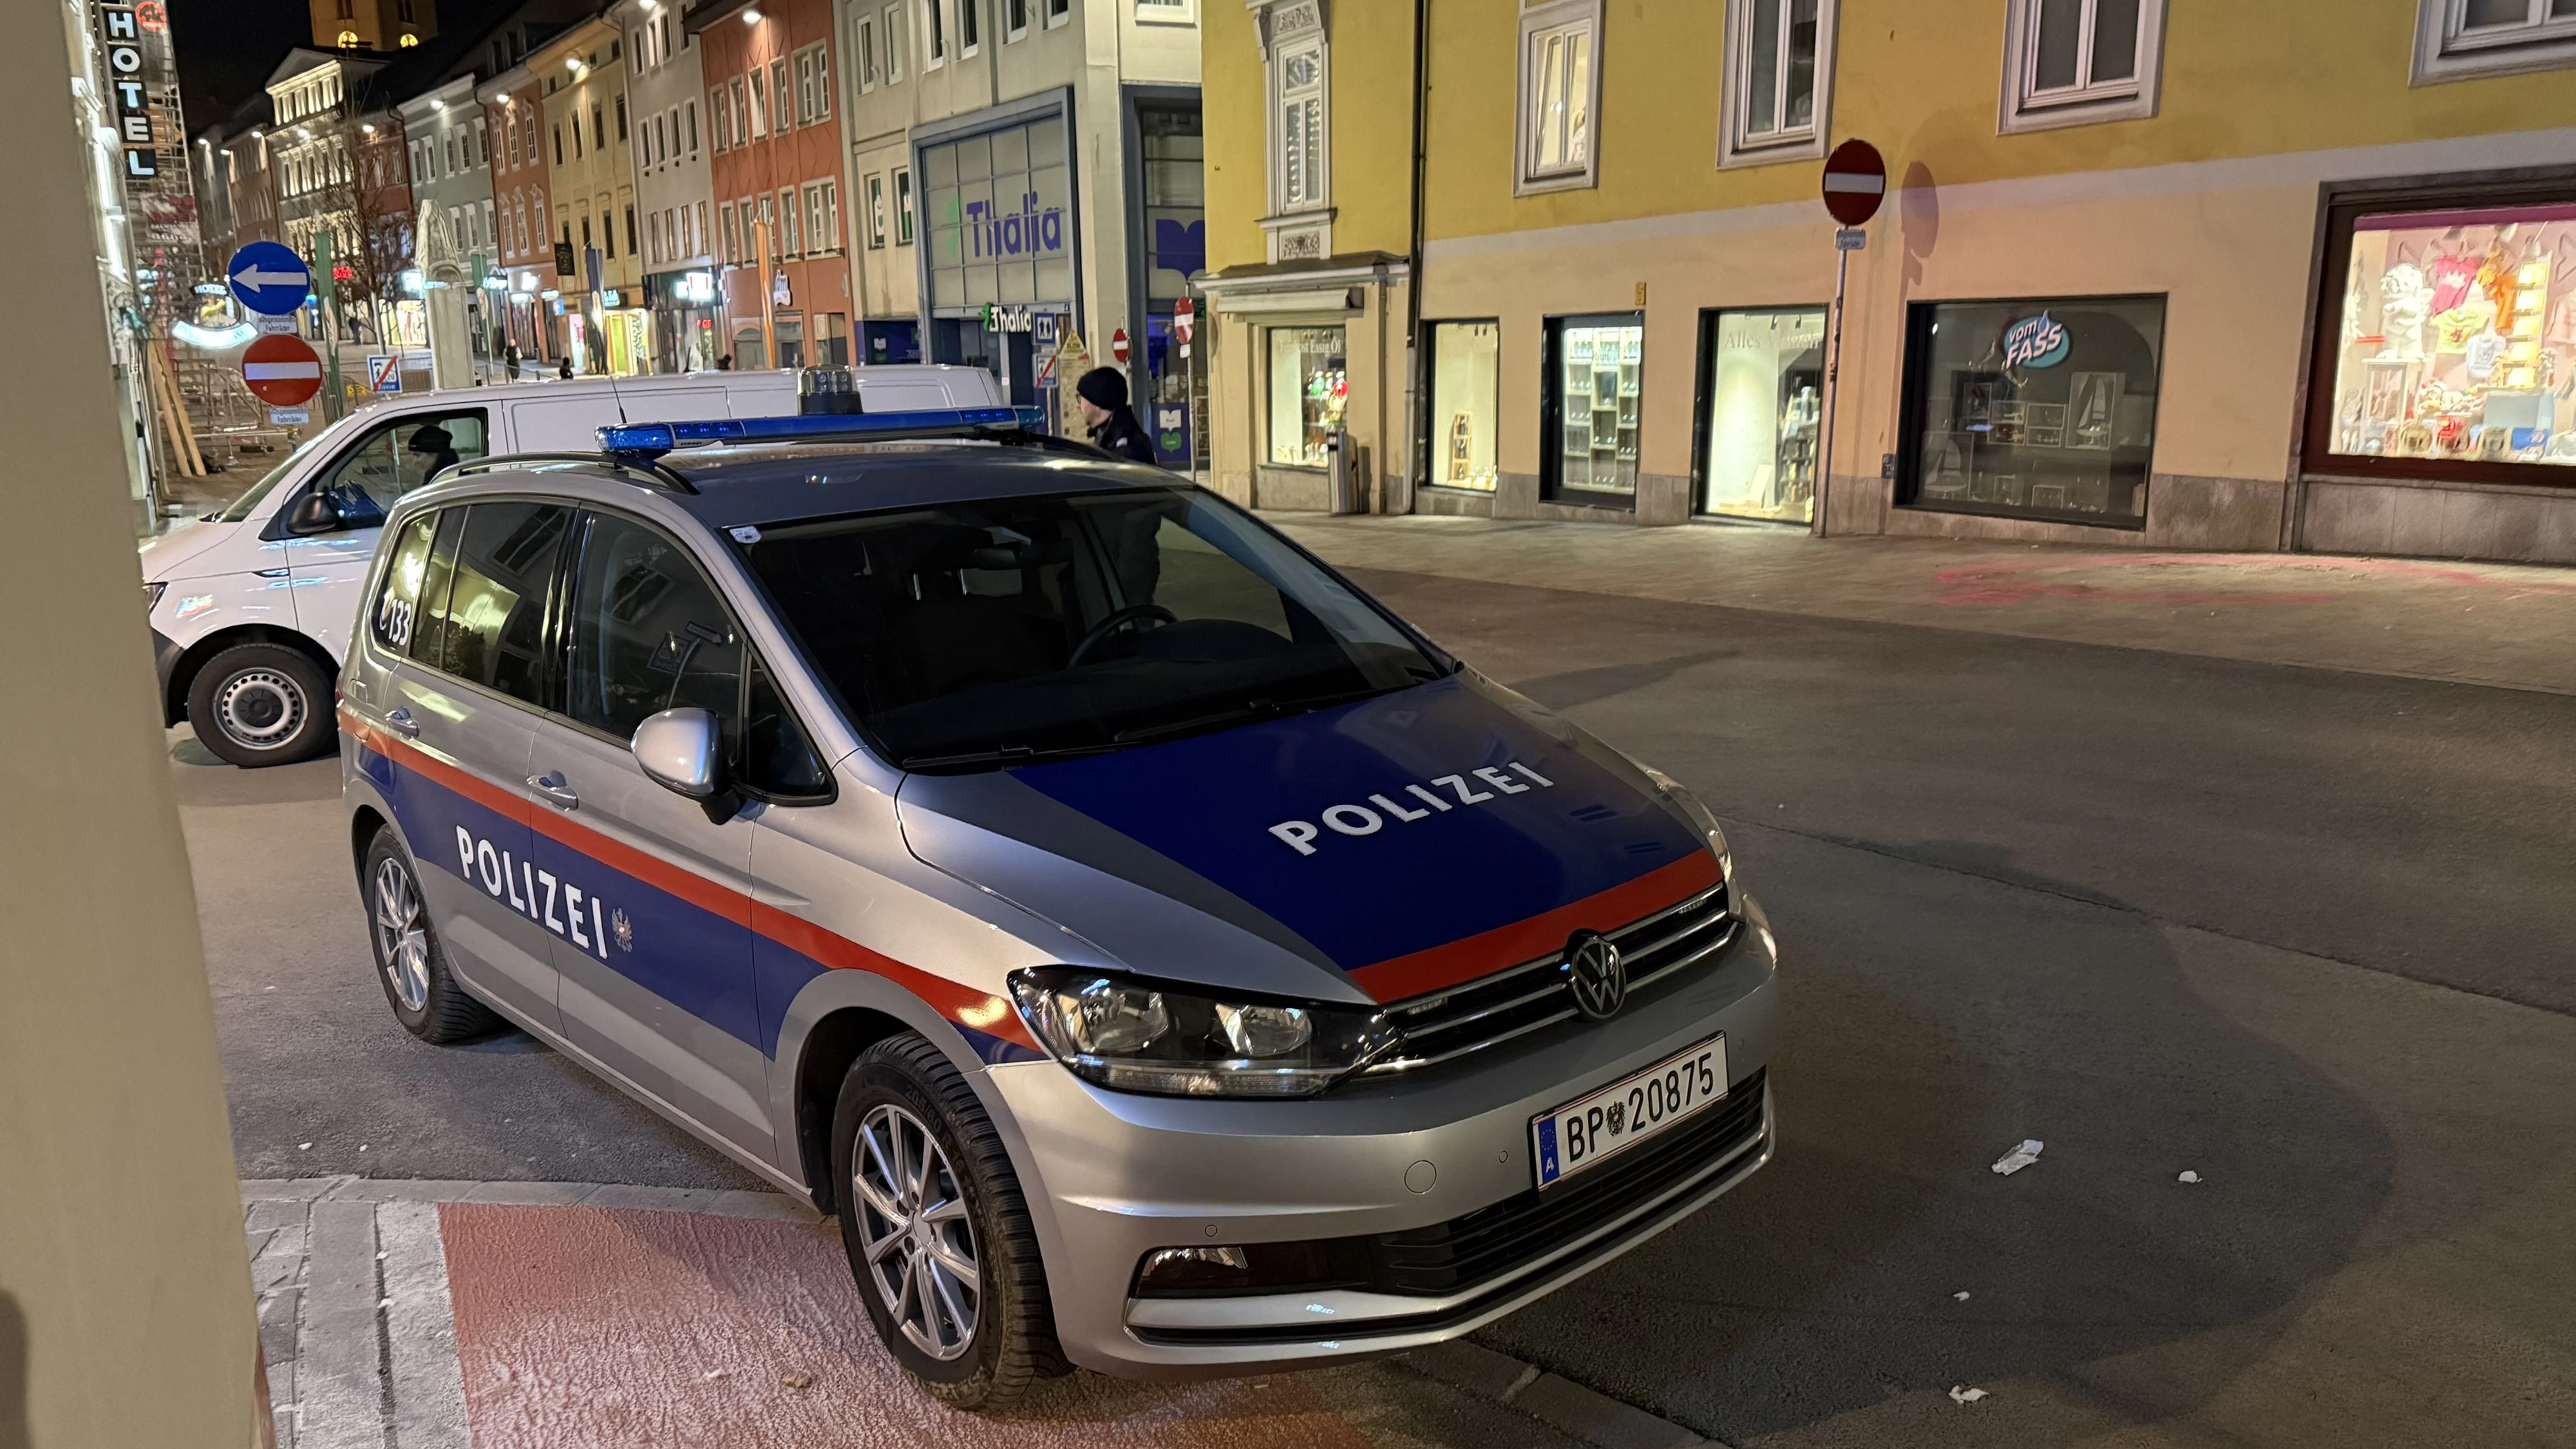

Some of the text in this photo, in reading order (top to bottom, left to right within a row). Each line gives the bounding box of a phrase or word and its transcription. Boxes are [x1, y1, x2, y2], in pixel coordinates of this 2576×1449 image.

[108, 12, 155, 175] HOTEL
[967, 191, 1061, 257] Thalia
[777, 274, 788, 292] dm
[989, 305, 1031, 332] Thalia
[1724, 330, 1761, 349] Alles
[2009, 319, 2038, 344] vom
[1311, 339, 1330, 357] Essig
[1331, 336, 1341, 354] Öl
[2006, 323, 2063, 369] FASS
[388, 599, 412, 646] 133
[1268, 761, 1555, 857] POLIZEI
[455, 825, 608, 960] POLIZEI
[905, 1084, 942, 1133] 205/60
[1567, 1051, 1714, 1164] BP 20875
[1545, 1156, 1555, 1174] A
